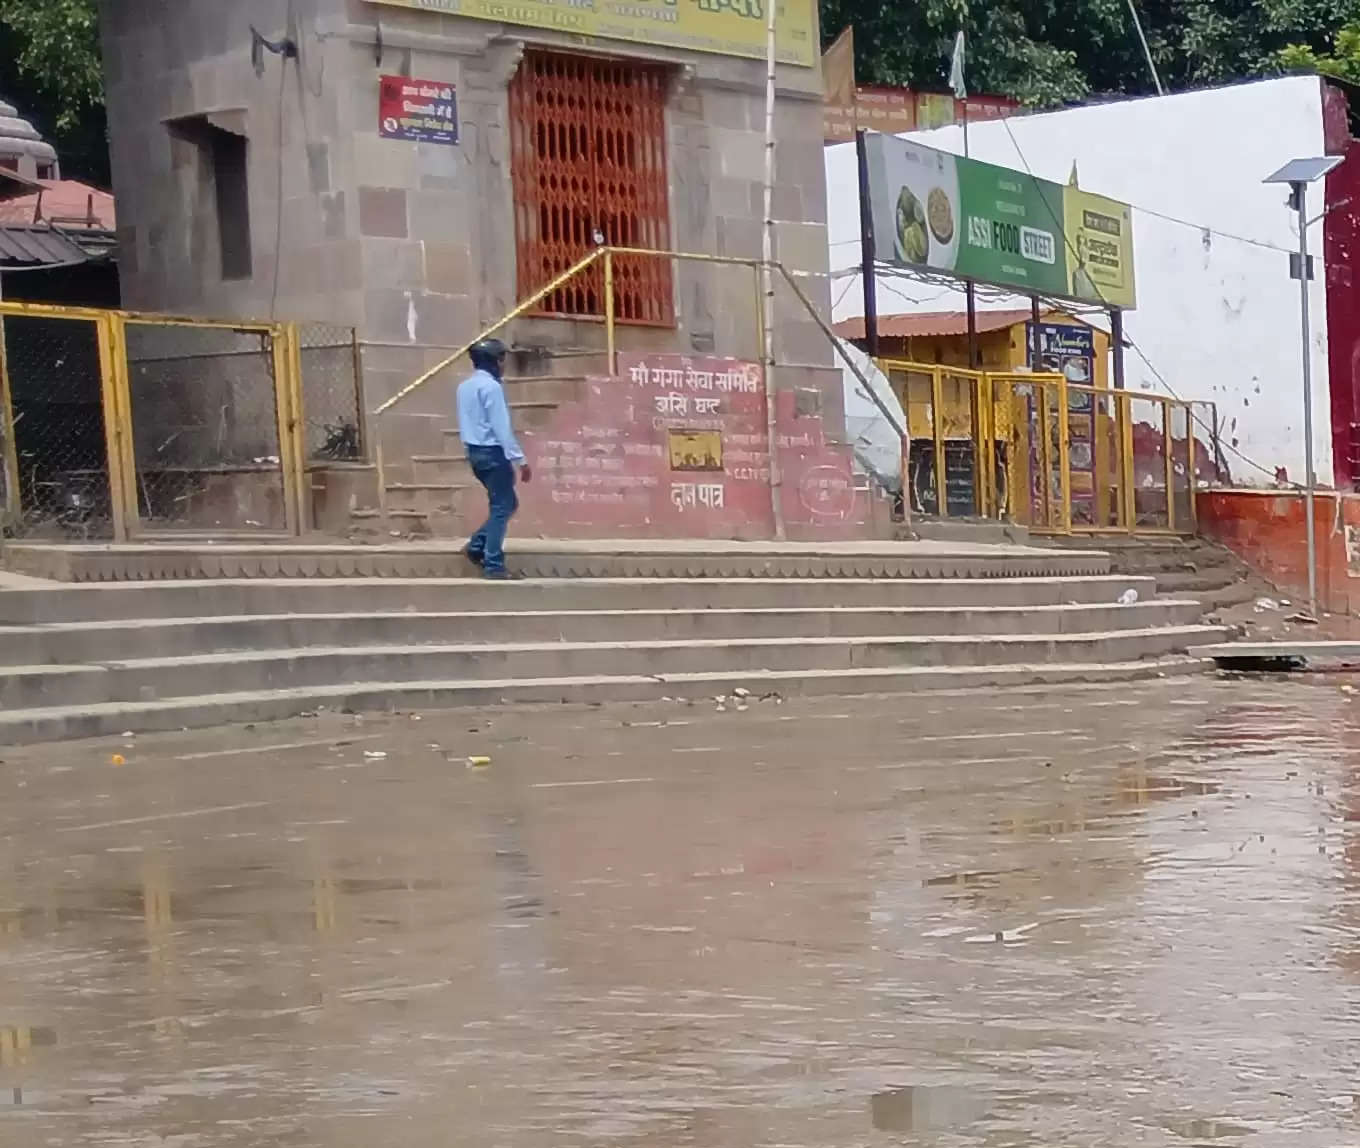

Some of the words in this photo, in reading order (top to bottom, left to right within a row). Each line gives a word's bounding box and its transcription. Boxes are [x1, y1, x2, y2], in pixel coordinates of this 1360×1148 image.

[968, 216, 992, 248] ASSI
[993, 221, 1020, 255] FOOD
[685, 366, 714, 391] सेवा
[698, 483, 724, 509] पात्र
